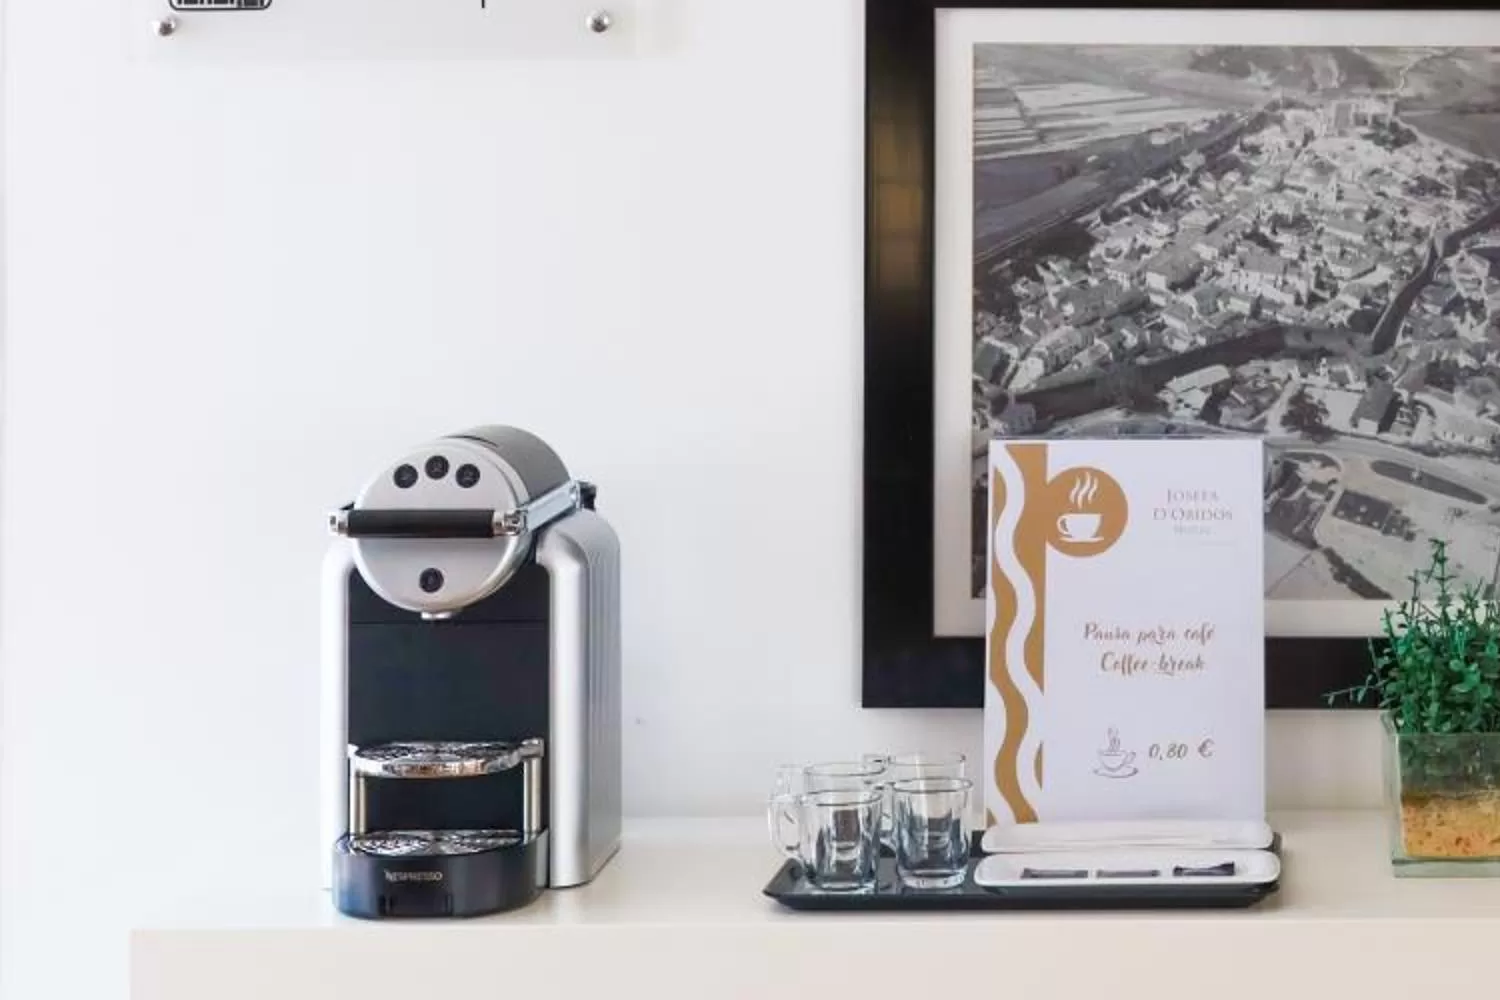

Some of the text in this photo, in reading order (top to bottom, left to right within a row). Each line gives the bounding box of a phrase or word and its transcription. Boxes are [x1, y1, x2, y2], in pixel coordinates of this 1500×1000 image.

[1084, 622, 1130, 641] Pausa
[1137, 624, 1175, 645] para
[1198, 738, 1215, 758] €
